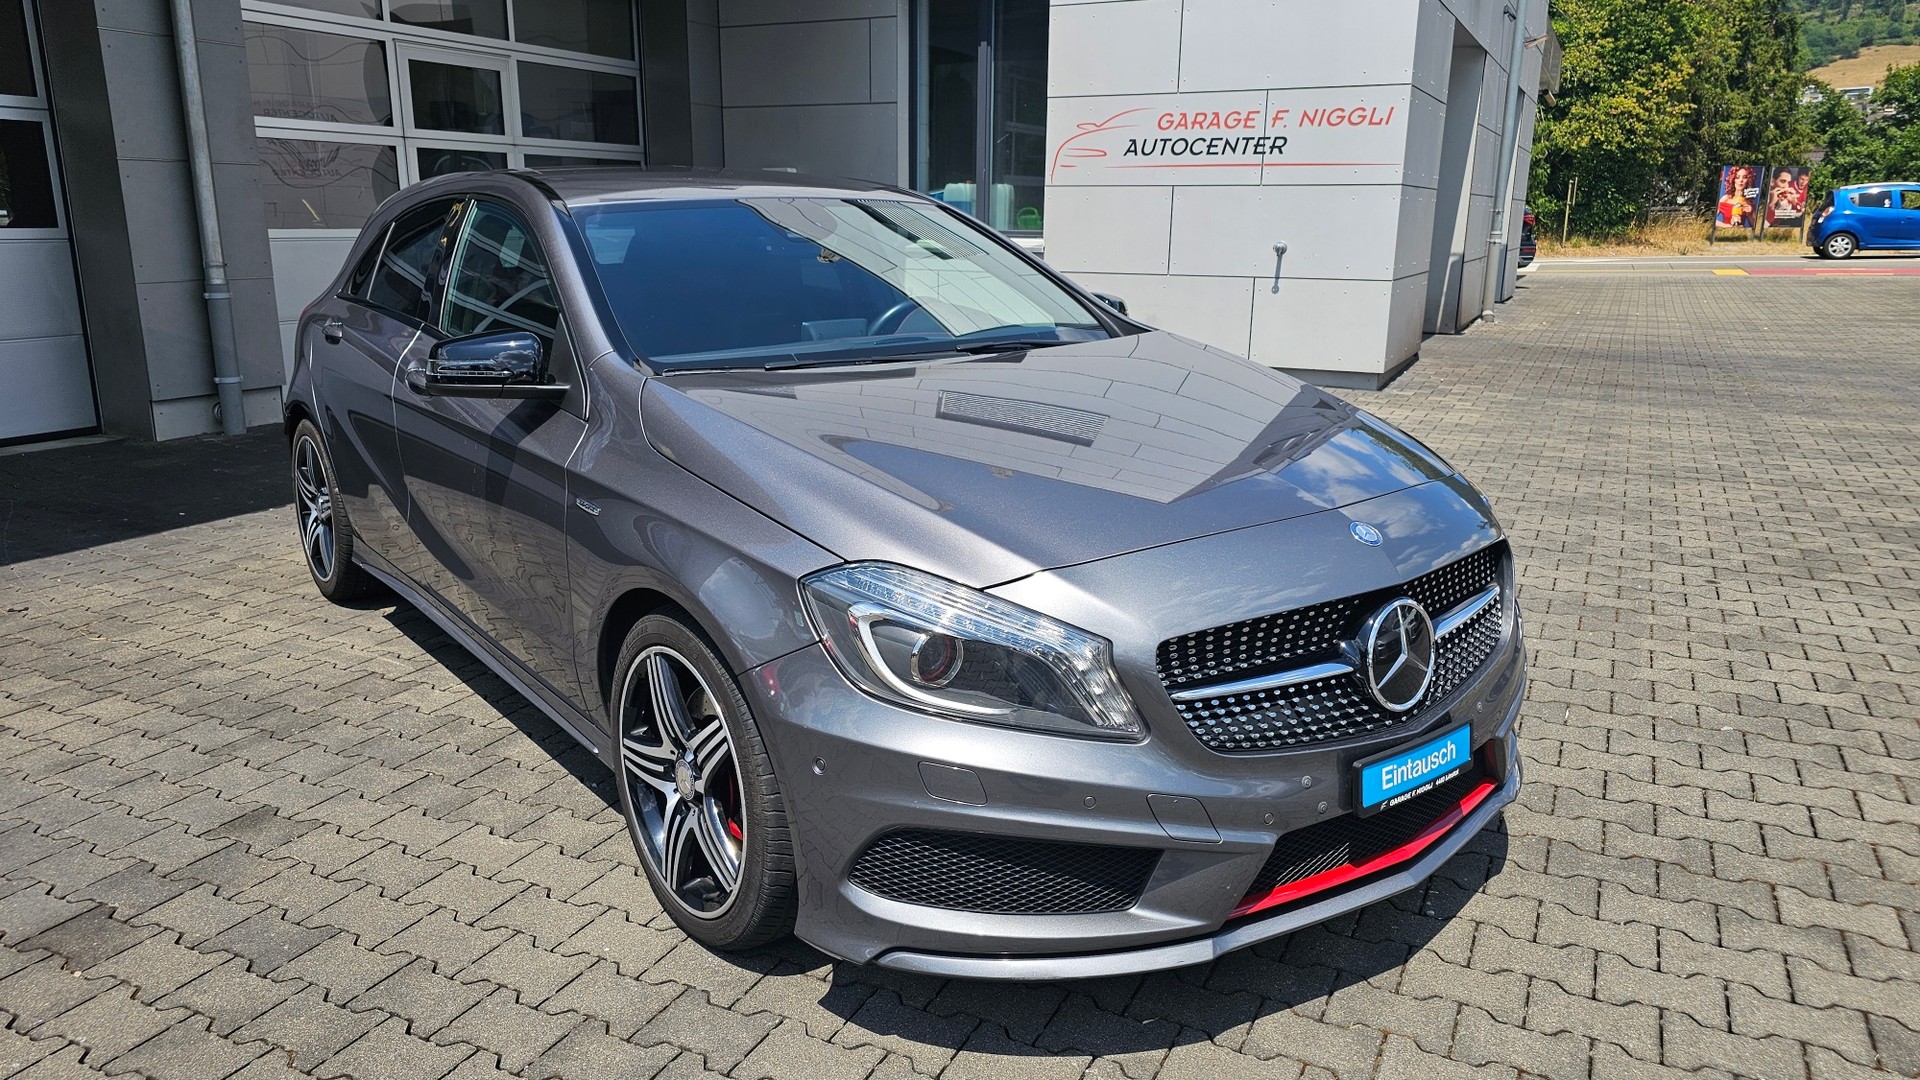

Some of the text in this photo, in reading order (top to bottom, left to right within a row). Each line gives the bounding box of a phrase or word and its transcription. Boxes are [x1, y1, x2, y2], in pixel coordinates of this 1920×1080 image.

[1157, 106, 1395, 131] GARAGE F. NIGGLI
[1123, 136, 1289, 157] AUTOCENTER
[1382, 740, 1457, 790] Eintausch
